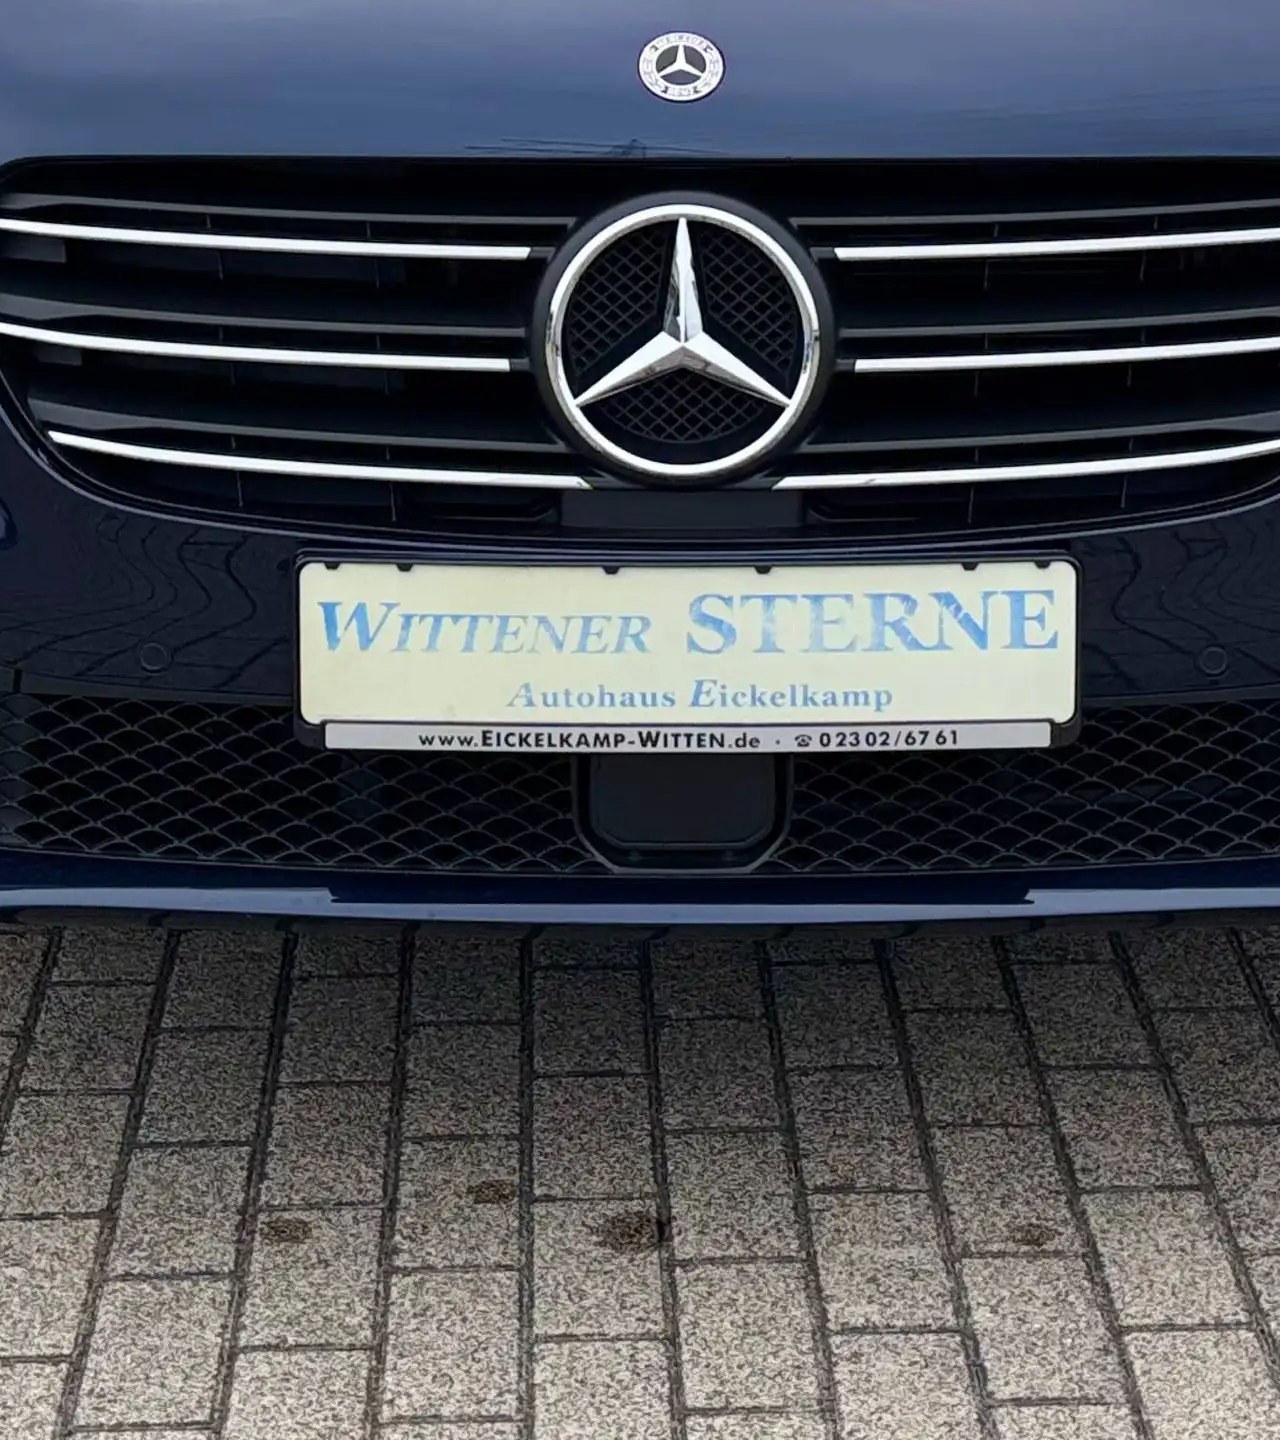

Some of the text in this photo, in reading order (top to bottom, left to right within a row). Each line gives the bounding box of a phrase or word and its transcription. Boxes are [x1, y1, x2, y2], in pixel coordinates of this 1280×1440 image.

[317, 589, 1059, 654] WITTENER STERNE
[506, 678, 893, 712] Autohaus Eickelkamp
